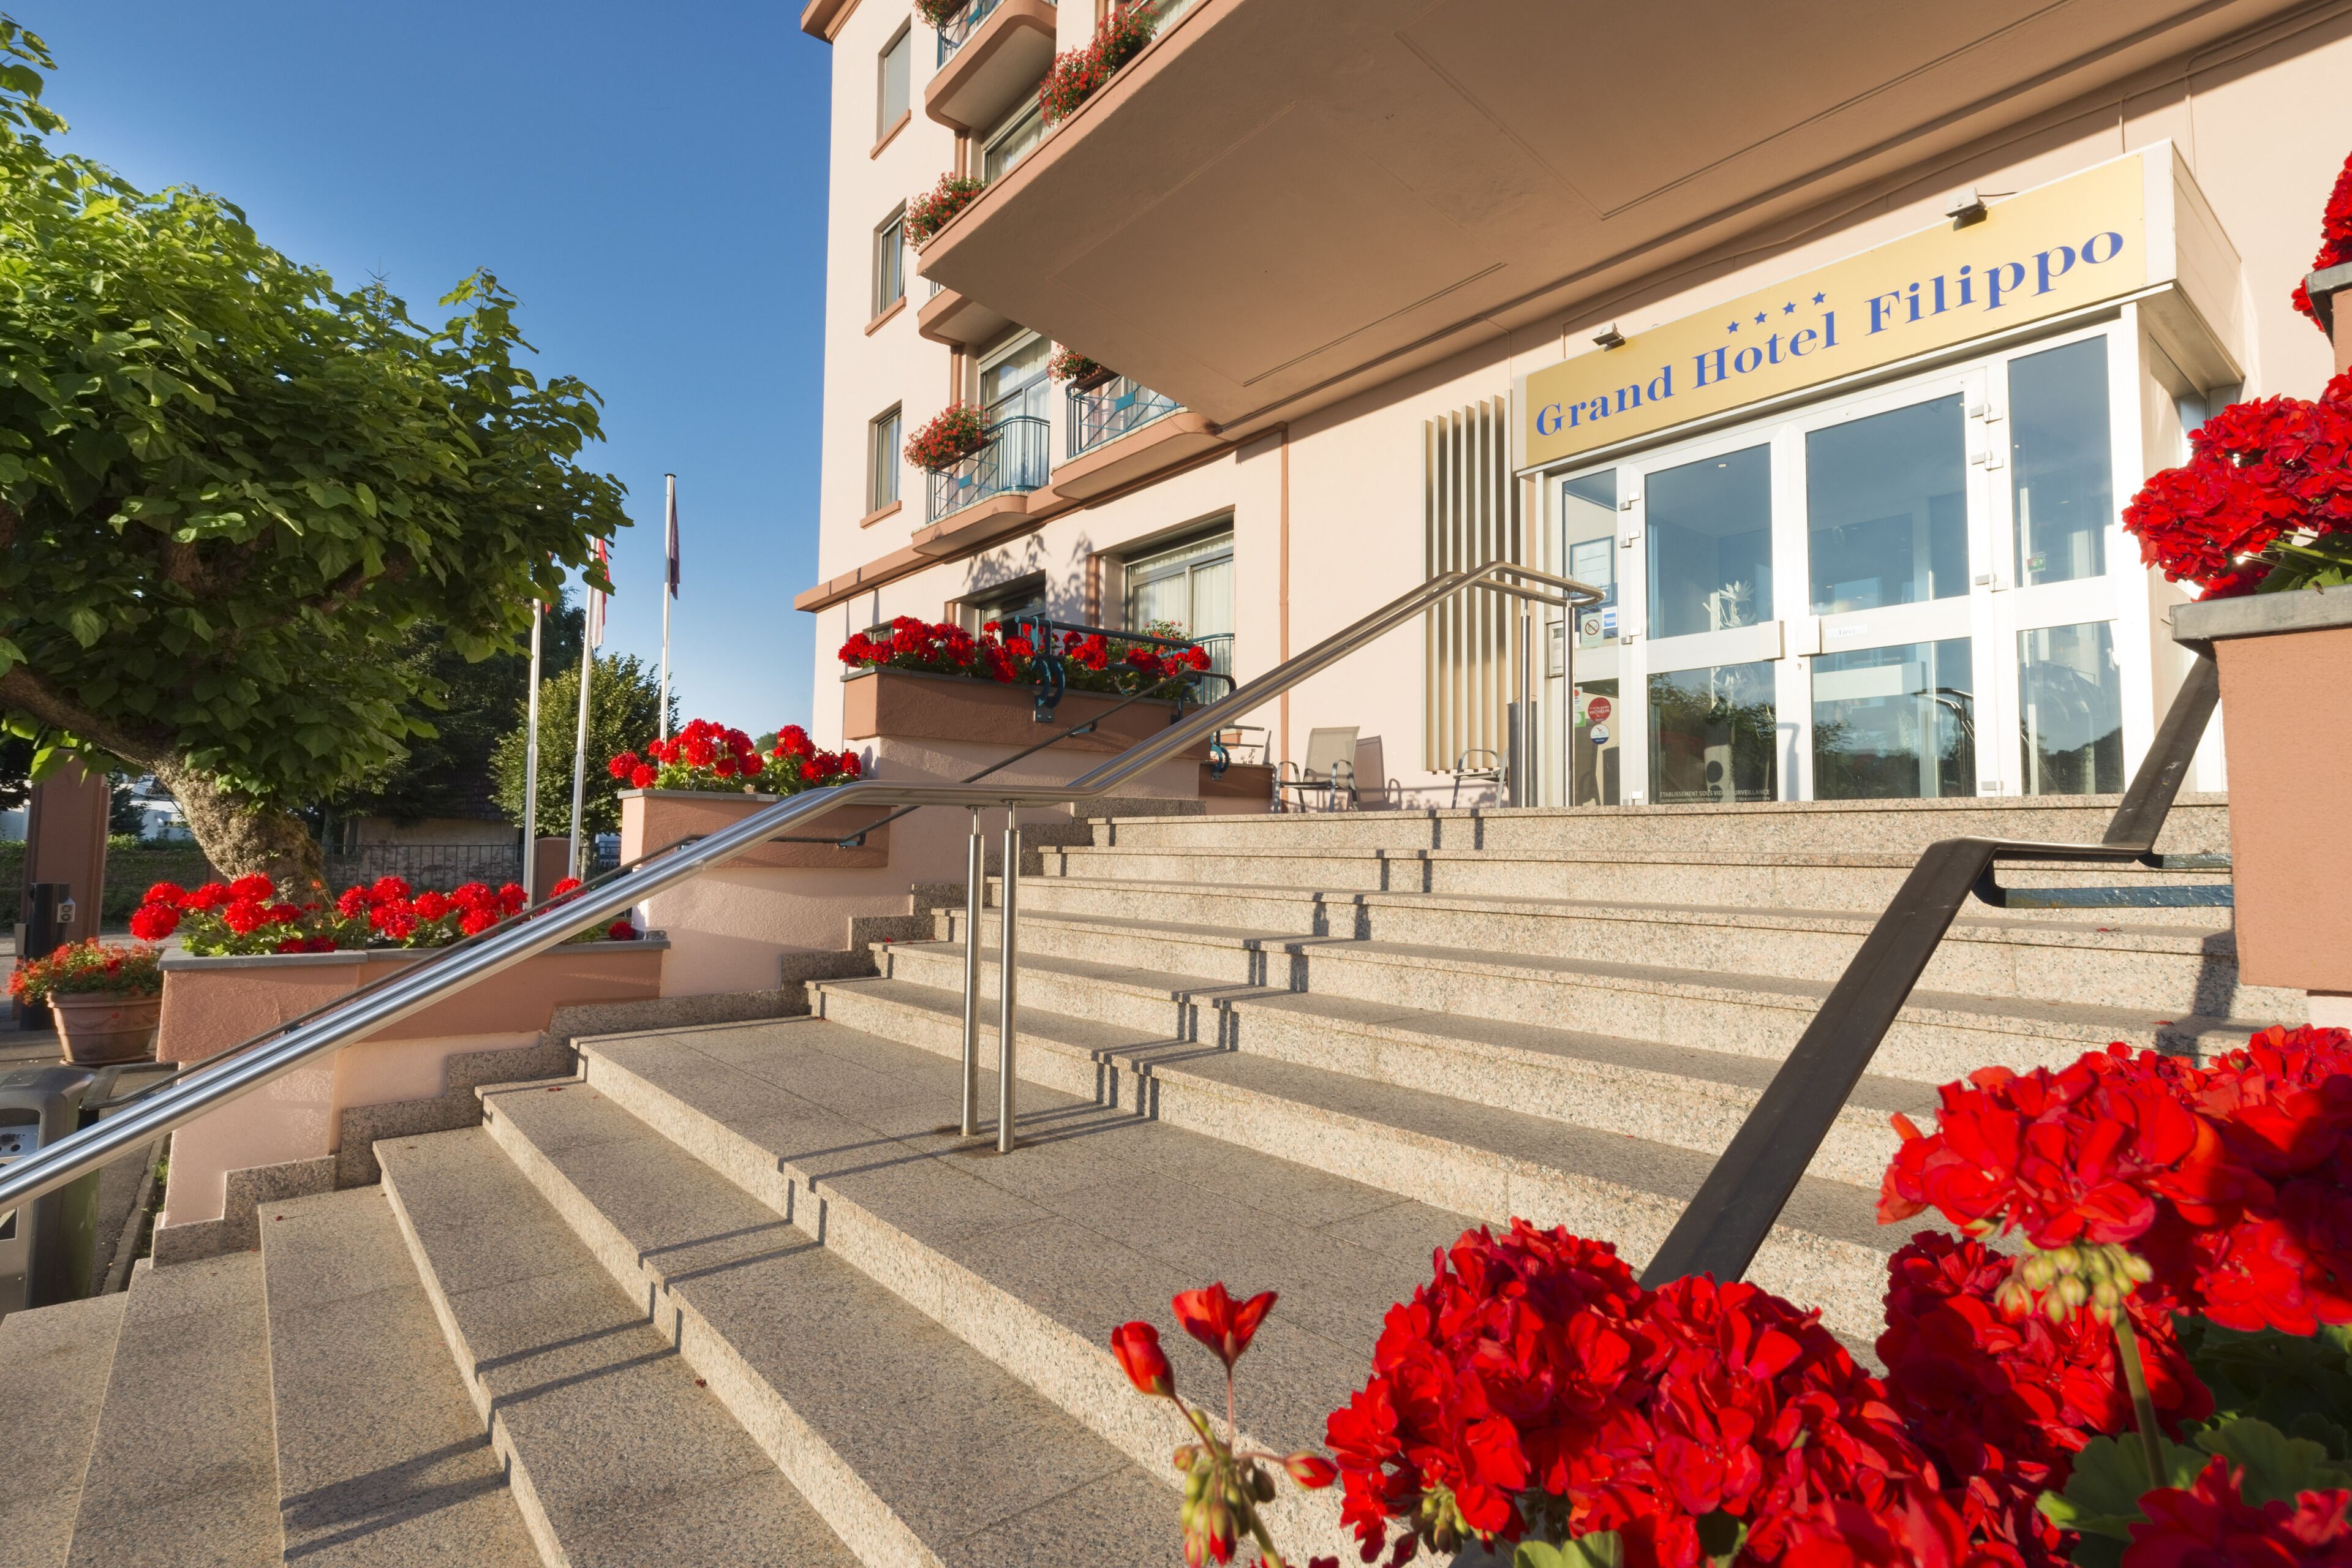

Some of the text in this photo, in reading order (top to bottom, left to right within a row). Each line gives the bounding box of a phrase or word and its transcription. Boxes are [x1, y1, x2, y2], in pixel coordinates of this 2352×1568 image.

[1536, 231, 2124, 436] Grand Hotel Filippo
